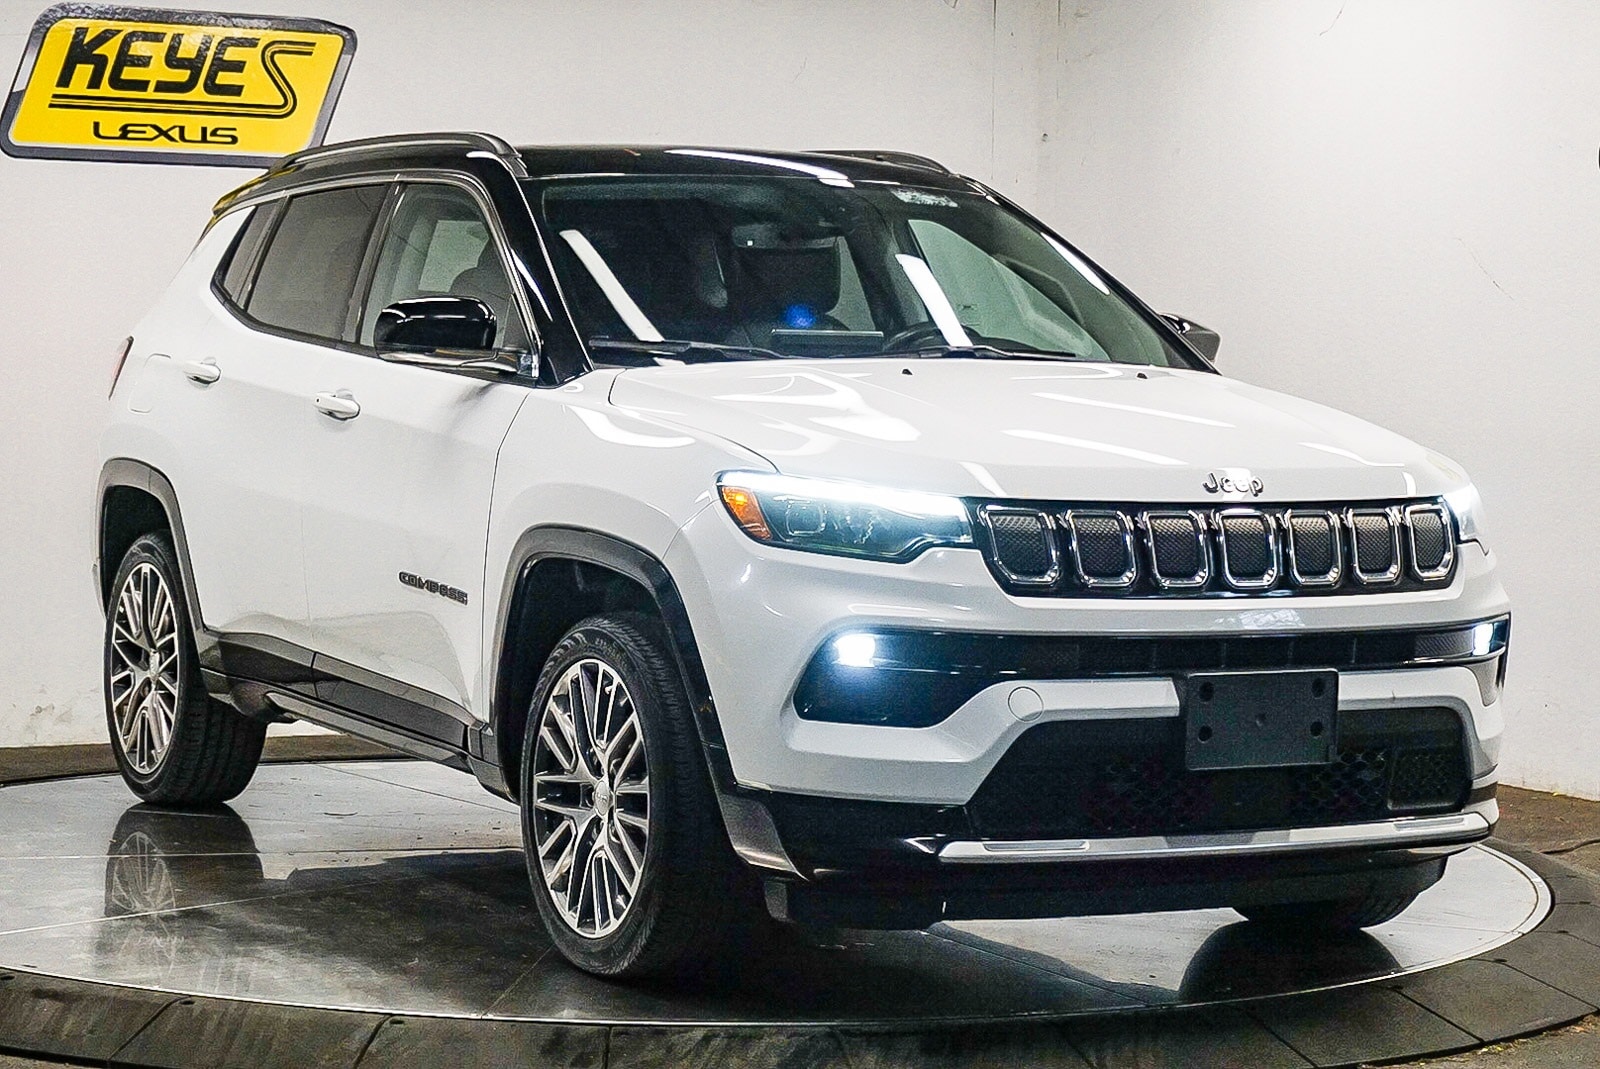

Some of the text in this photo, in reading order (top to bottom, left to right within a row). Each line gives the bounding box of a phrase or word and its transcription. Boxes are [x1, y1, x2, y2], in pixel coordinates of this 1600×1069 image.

[54, 26, 317, 119] KEYES
[93, 121, 239, 145] LEXUS
[1202, 472, 1264, 497] Jeep
[399, 571, 468, 605] COMPASS
